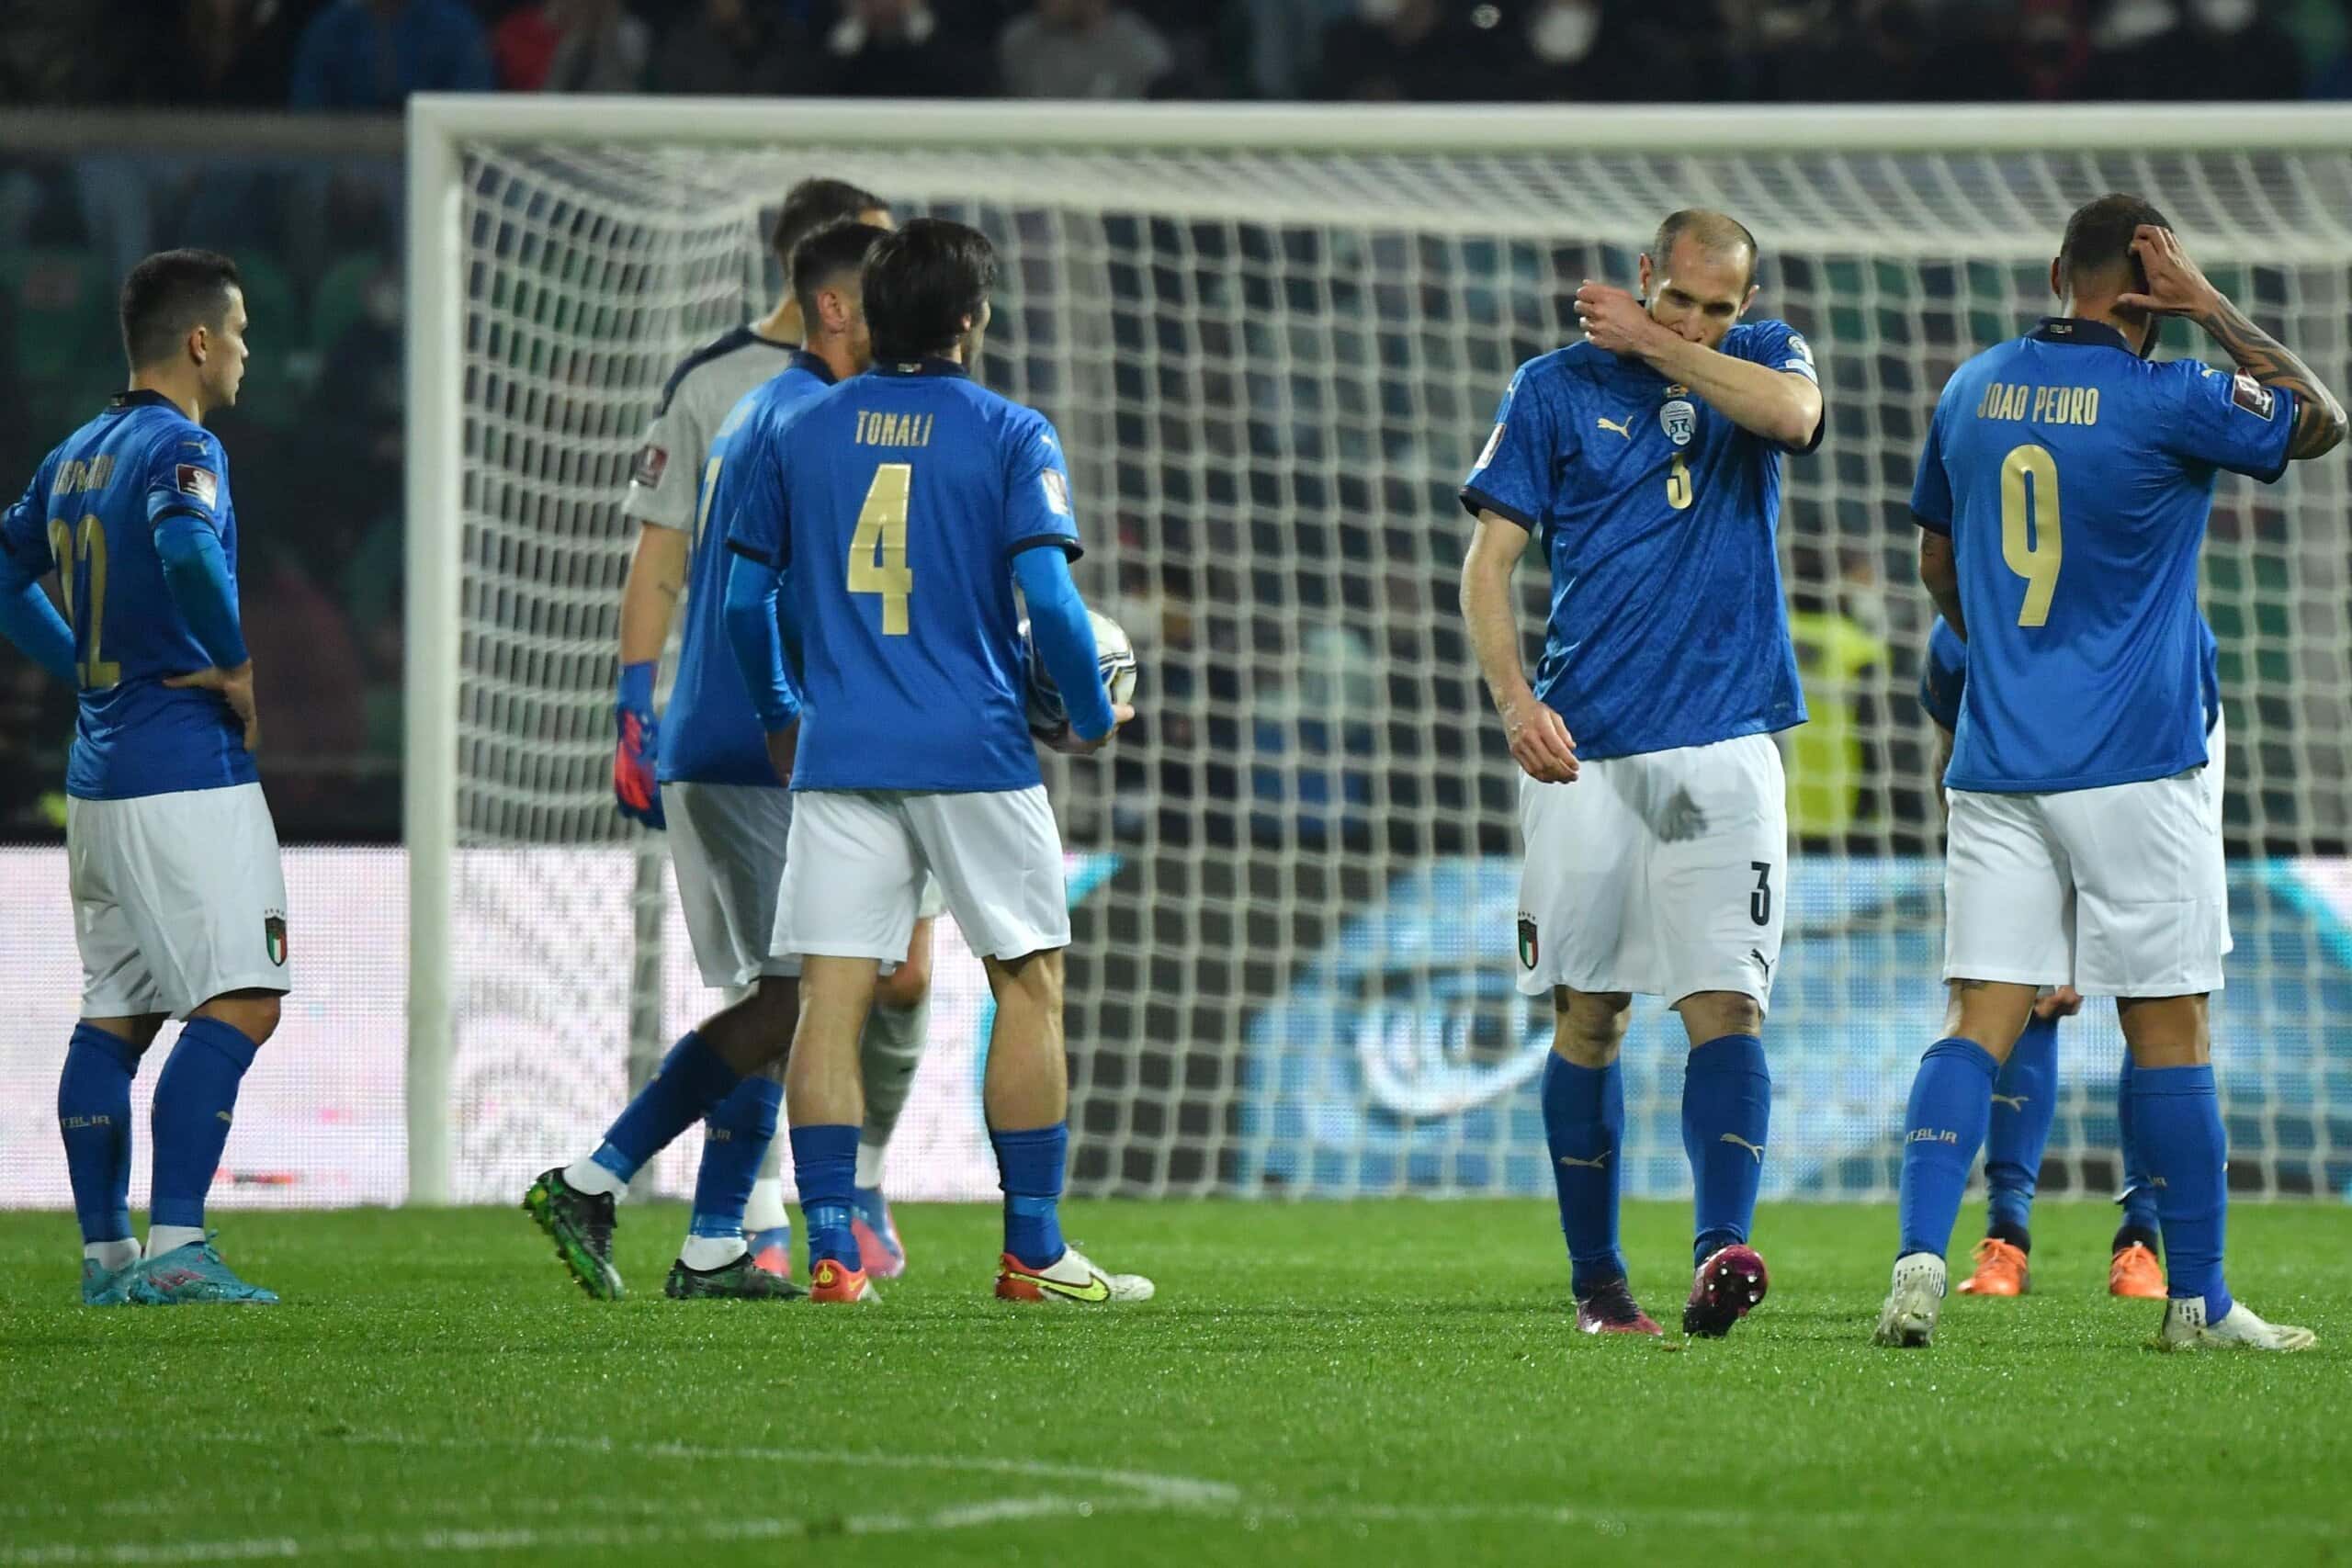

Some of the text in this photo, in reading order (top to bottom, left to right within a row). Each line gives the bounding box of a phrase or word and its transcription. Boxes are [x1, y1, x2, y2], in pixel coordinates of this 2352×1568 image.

[855, 411, 934, 446] TONALI
[1977, 382, 2099, 425] JOAO PEDRO
[847, 463, 912, 635] 4
[2001, 444, 2063, 627] 9
[1750, 861, 1771, 926] 3
